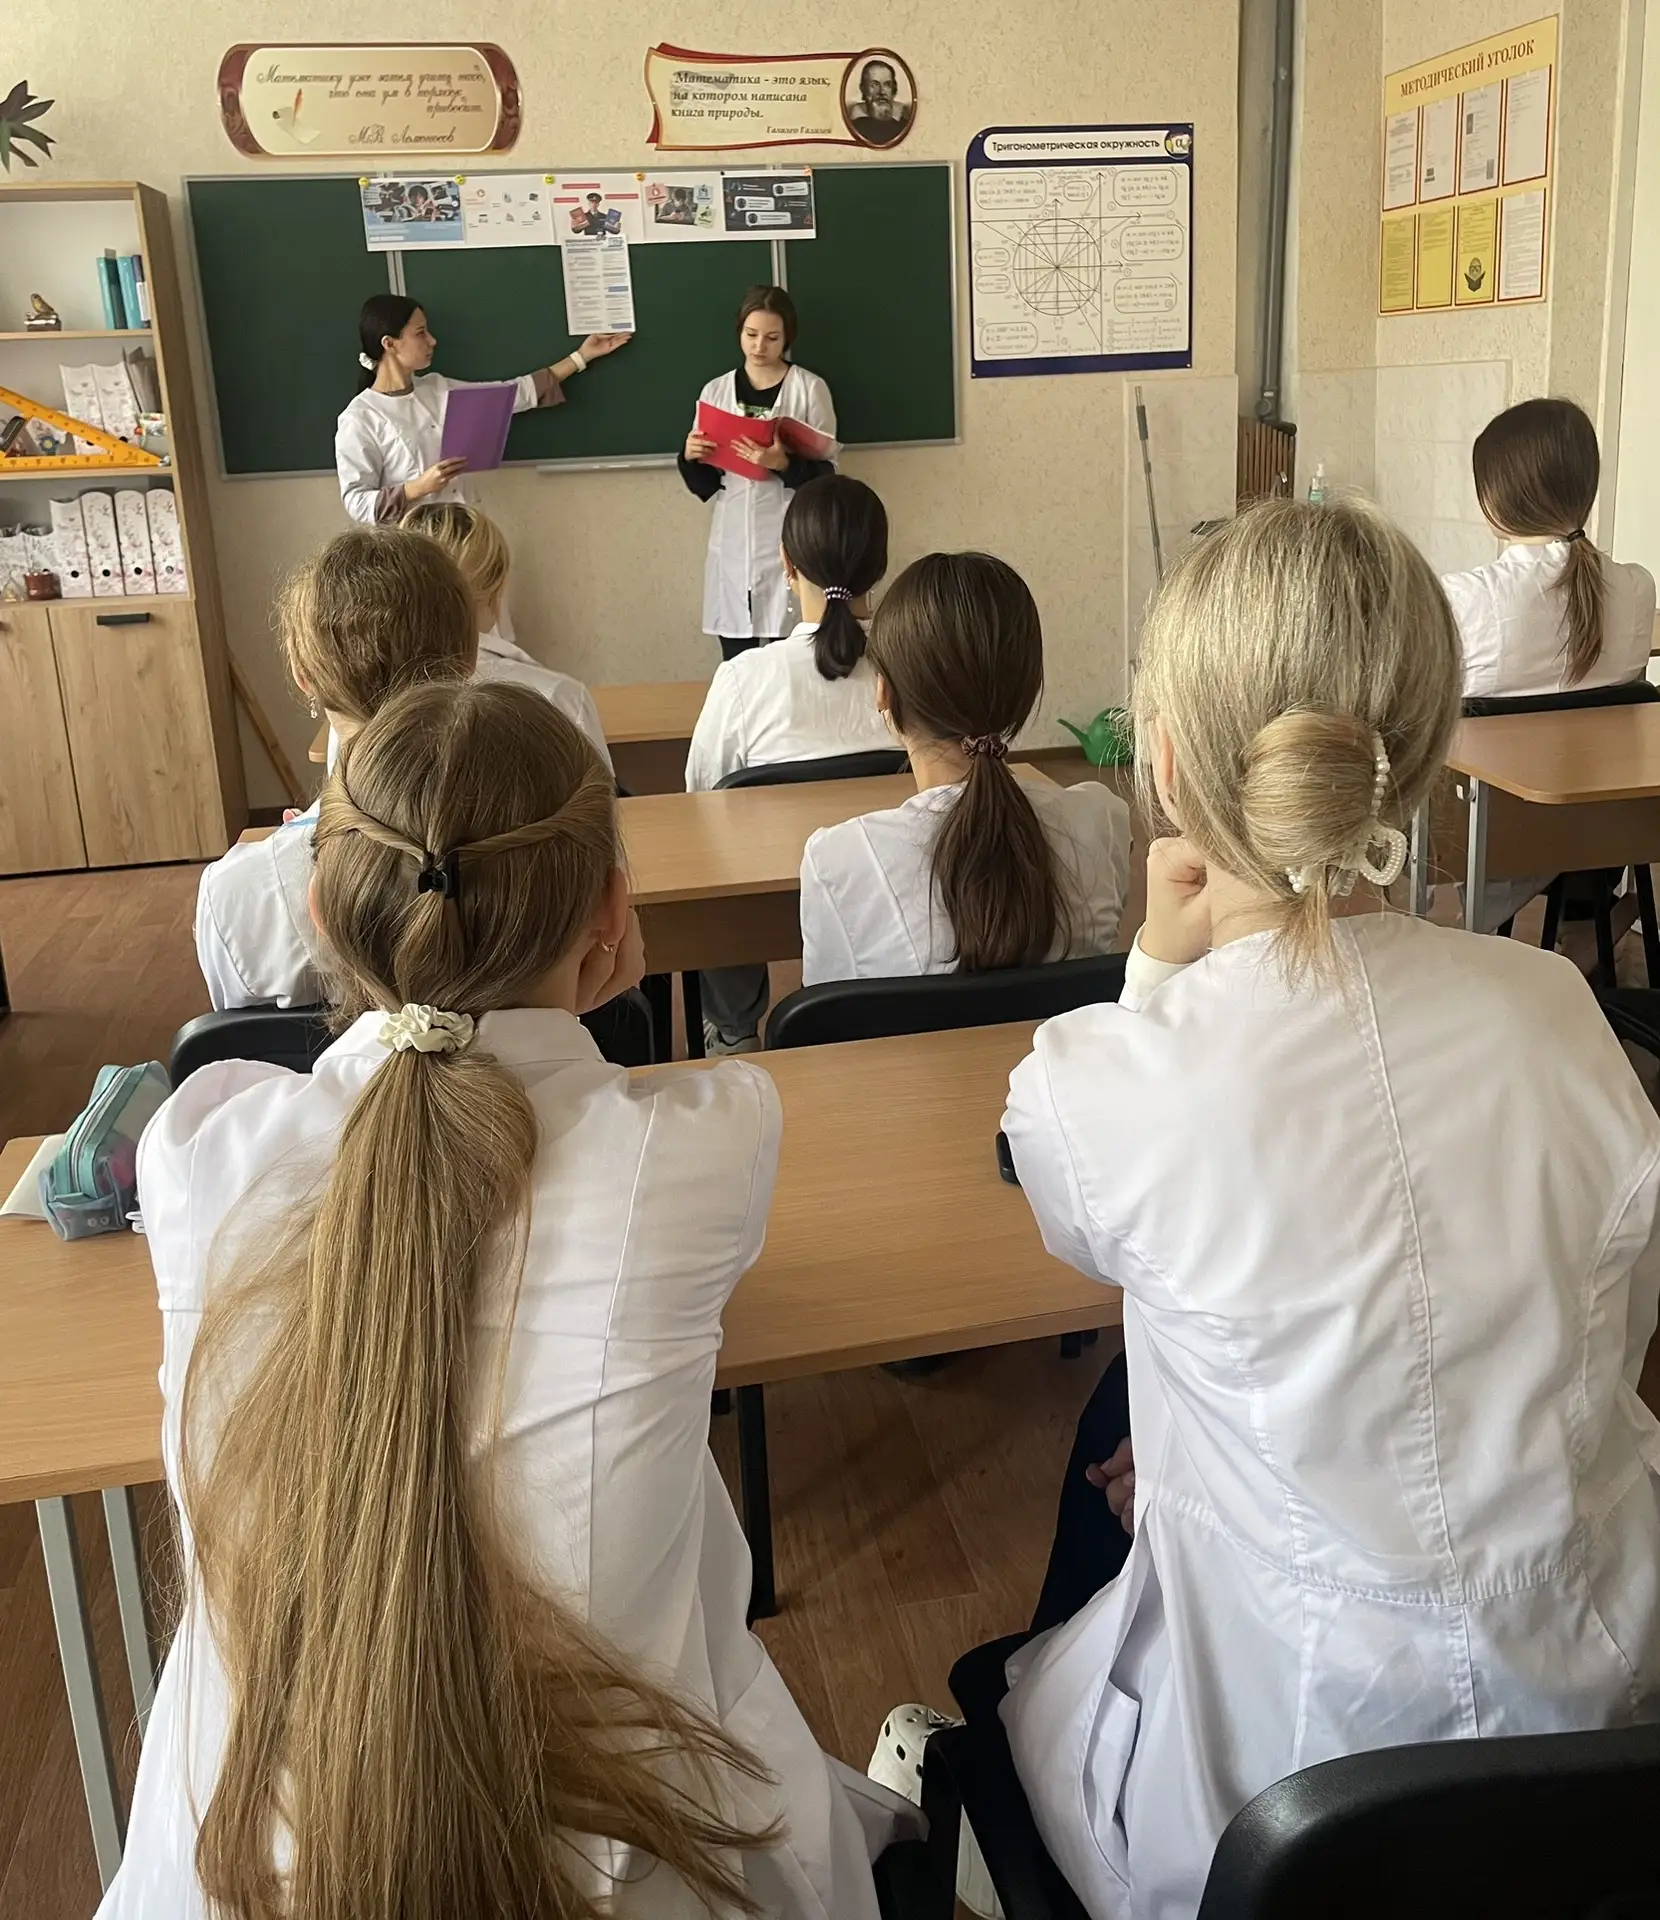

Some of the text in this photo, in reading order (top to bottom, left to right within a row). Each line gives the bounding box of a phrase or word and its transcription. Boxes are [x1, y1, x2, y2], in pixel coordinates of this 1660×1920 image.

[1400, 39, 1535, 97] МЕТОДИЧЕСКИЙ УГОЛОК
[675, 71, 761, 87] Математика
[772, 75, 796, 86] это
[799, 76, 831, 87] язык,
[673, 91, 807, 103] на котором написана
[671, 108, 764, 121] книга природы.
[992, 139, 1160, 152] Тригонометрическая окружность
